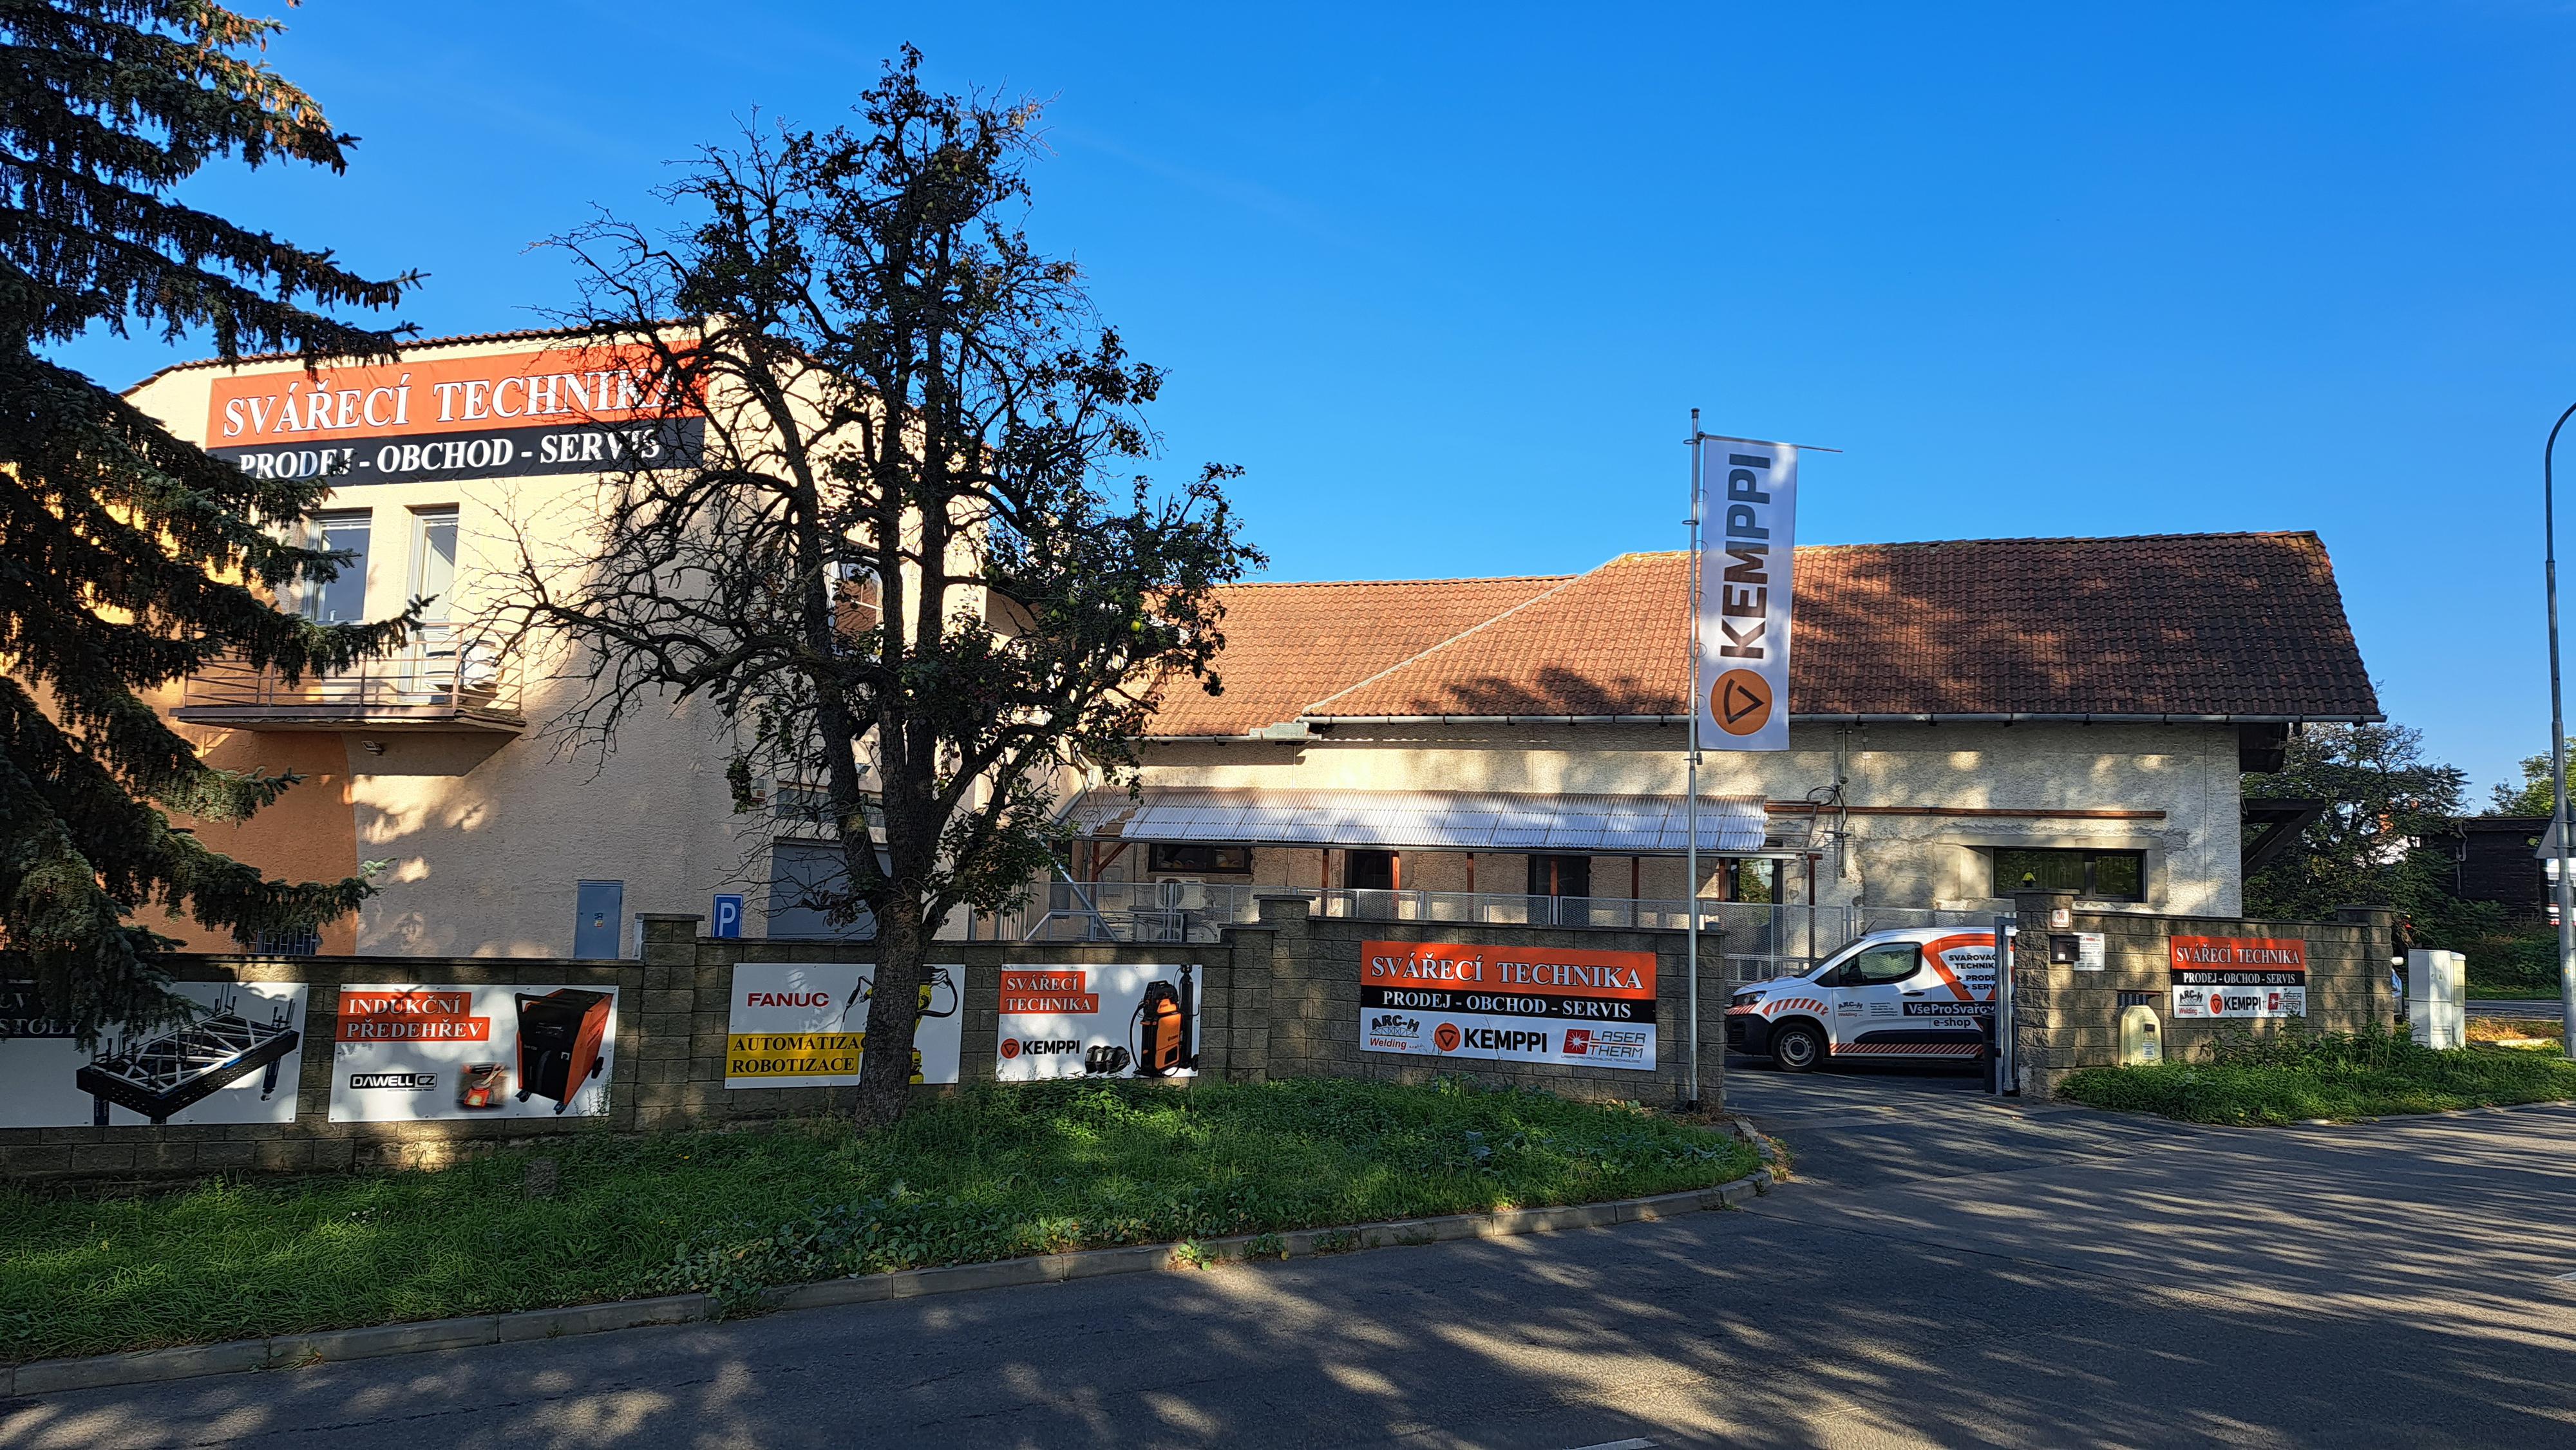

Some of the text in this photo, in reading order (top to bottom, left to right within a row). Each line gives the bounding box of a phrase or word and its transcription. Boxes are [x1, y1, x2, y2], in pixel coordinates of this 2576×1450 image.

[223, 366, 679, 437] SVÁŘECÍ TECHNIKA
[239, 448, 354, 478] PRODEJ
[377, 438, 513, 473] OBCHOD
[540, 429, 659, 464] SERVIS
[1720, 453, 1771, 659] KEMPPI
[719, 901, 736, 936] P
[2176, 943, 2300, 964] SVÁŘECÍ TECHNIKA
[1371, 952, 1644, 990] SVÁŘECÍ TECHNIKA
[2183, 972, 2217, 983] PRODEJ
[2224, 973, 2260, 984] OBCHOD
[2266, 974, 2295, 984] SERVIS
[1007, 974, 1078, 991] SVÁŘECÍ
[348, 995, 461, 1013] INDUKČNÍ
[747, 993, 829, 1007] FANUC
[1005, 997, 1092, 1011] TECHNIKA
[1383, 990, 1452, 1008] PRODEJ
[1466, 995, 1546, 1013] OBCHOD
[1562, 1000, 1631, 1019] SERVIS
[2179, 990, 2203, 1003] ARC-H
[2224, 996, 2261, 1011] KEMPPI
[2179, 1007, 2197, 1015] Welding
[346, 1018, 483, 1038] PŘEDEHŘEV
[1372, 1015, 1419, 1032] ARC-H
[1933, 1017, 1971, 1028] e-shop
[1370, 1038, 1406, 1050] Welding
[1464, 1028, 1547, 1053] KEMPPI
[1591, 1030, 1646, 1044] LASER
[1022, 1040, 1080, 1055] KEMPPI
[1589, 1045, 1643, 1058] THERM
[731, 1057, 855, 1073] ROBOTIZACE
[352, 1075, 435, 1087] DAWELL CZ
